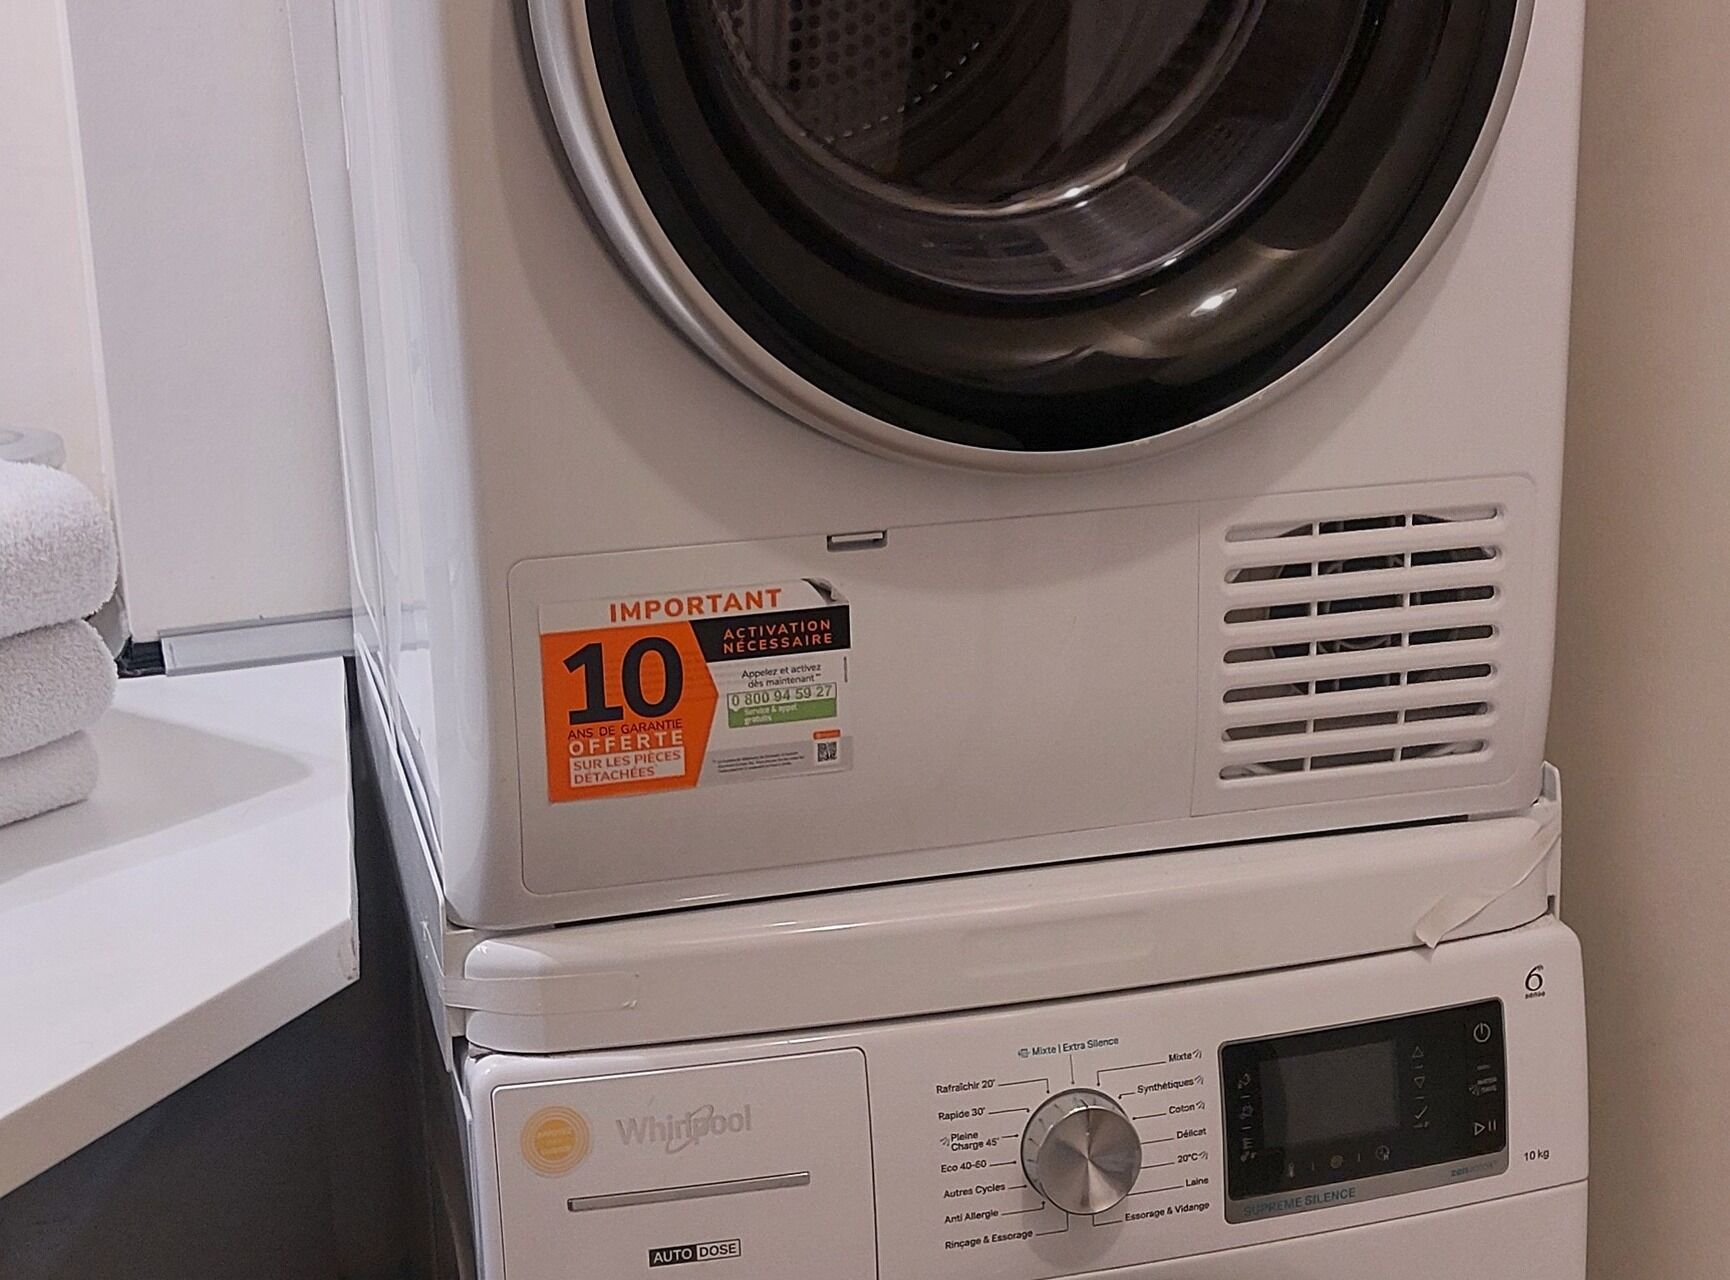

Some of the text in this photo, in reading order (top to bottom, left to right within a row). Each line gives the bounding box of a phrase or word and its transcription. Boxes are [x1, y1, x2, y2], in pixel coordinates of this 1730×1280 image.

[610, 588, 783, 624] IMPORTANT
[723, 619, 831, 641] ACTIVATION
[723, 632, 833, 654] NÉCESSAIRE
[741, 663, 821, 680] Appelez et activez
[562, 636, 684, 726] 10
[748, 679, 764, 688] dès
[731, 684, 833, 707] 0 800 94 59 27
[568, 718, 683, 740] ANS DE GARANTIE
[569, 729, 683, 756] OFFERTE
[573, 748, 681, 772] SUR LES PIÈCES
[1032, 1046, 1056, 1056] Mixte
[1062, 1042, 1086, 1052] Extra
[1087, 1037, 1119, 1049] Silence
[1168, 1052, 1192, 1062] Mixte
[936, 1078, 996, 1094] Rafraîchir 20'
[1137, 1078, 1195, 1095] Synthétiques
[938, 1106, 986, 1121] Rapide 30'
[1168, 1103, 1195, 1115] Coton
[615, 1104, 752, 1154] Whirlpool
[951, 1132, 978, 1142] Pleine
[1176, 1127, 1207, 1139] Délicat
[951, 1140, 984, 1152] Charge
[1524, 1148, 1550, 1161] 10 kg
[941, 1159, 987, 1173] Eco 40-60
[1177, 1152, 1198, 1164] 20°C
[1185, 1177, 1209, 1187] Laine
[943, 1183, 1006, 1199] Autres Cycles
[1243, 1187, 1357, 1217] SUPREME SILENCE
[944, 1209, 999, 1224] Anti Allergie
[1125, 1201, 1210, 1221] Essorage & Vidange
[945, 1230, 1034, 1250] Rinçage & Essorage
[653, 1242, 738, 1265] AUTO DOSE
